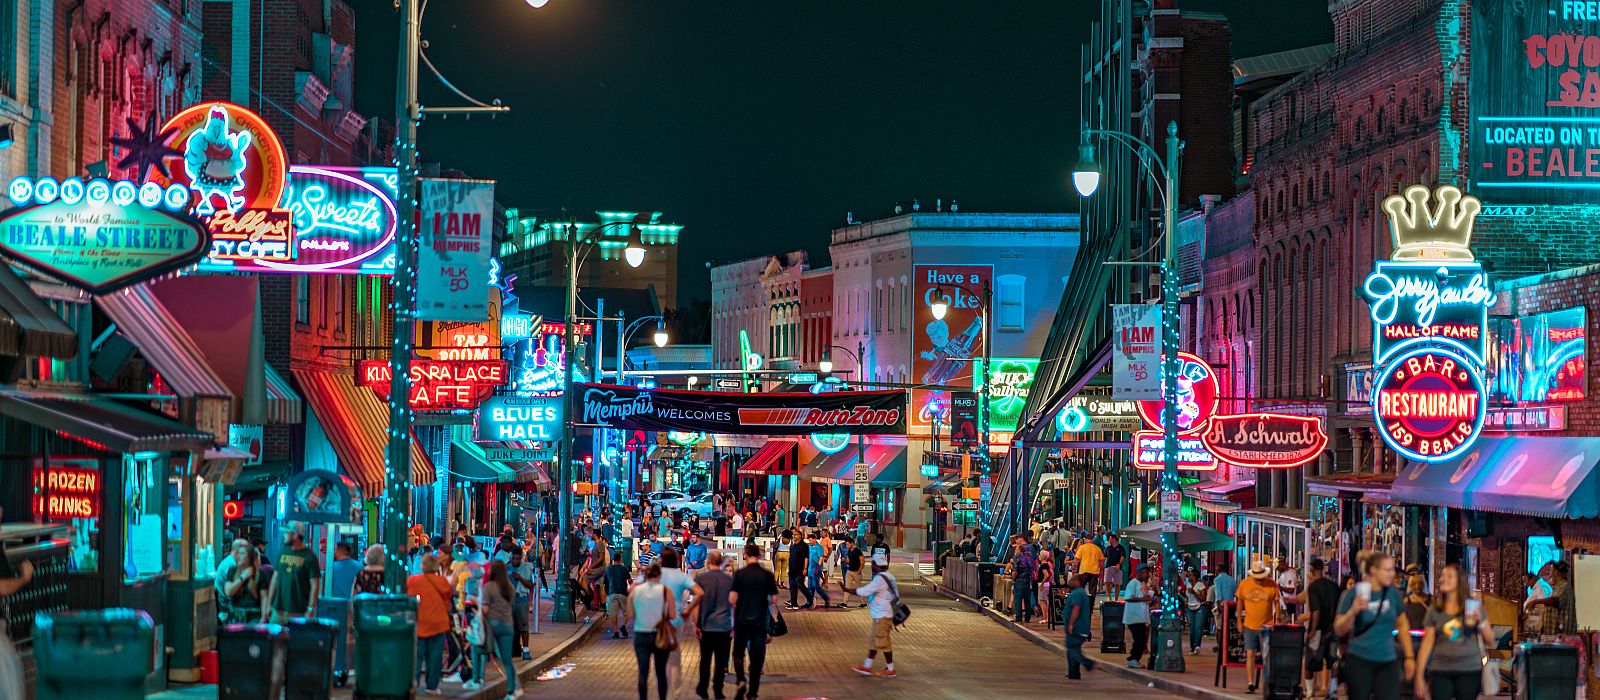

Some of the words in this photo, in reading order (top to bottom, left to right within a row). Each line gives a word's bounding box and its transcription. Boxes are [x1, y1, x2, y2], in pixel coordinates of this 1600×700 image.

[235, 116, 270, 153] CHICKEN
[1485, 127, 1555, 144] LOCATED
[1560, 127, 1582, 144] ON
[1506, 148, 1600, 177] BEALE
[299, 186, 381, 234] Sweets
[66, 212, 99, 224] World
[102, 214, 140, 225] Famous
[434, 212, 441, 235] I
[446, 213, 481, 236] AM
[9, 225, 86, 246] BEALE
[96, 227, 188, 249] STREET
[237, 241, 287, 258] CAFE
[433, 239, 481, 252] MEMPHIS
[440, 266, 468, 278] MLK
[927, 269, 964, 283] Have
[970, 273, 979, 283] a
[449, 278, 469, 292] 50
[924, 287, 980, 309] Coke
[1365, 273, 1439, 326] Jerry
[1122, 327, 1127, 342] I
[1131, 326, 1155, 342] AM
[1385, 325, 1420, 336] HALL
[1421, 325, 1438, 336] OF
[1443, 325, 1478, 337] FAME
[454, 334, 488, 348] TAP
[1122, 345, 1155, 354] MEMPHIS
[1128, 363, 1147, 371] MLK
[1408, 354, 1455, 378] BAR
[1135, 371, 1148, 381] 50
[410, 385, 470, 404] AFE
[584, 399, 653, 424] Memphis
[657, 408, 731, 421] WELCOMES
[803, 406, 899, 425] AutoZone
[1381, 391, 1478, 417] RESTAURANT
[493, 408, 556, 421] BLUES
[500, 424, 550, 438] HALL
[1207, 420, 1231, 444] A.
[1234, 419, 1320, 445] Schwab
[1388, 422, 1413, 446] 159
[1419, 422, 1472, 455] BEALE
[491, 451, 514, 459] JUKE
[521, 451, 548, 459] JOINT
[1229, 450, 1284, 460] ESTABLISHED
